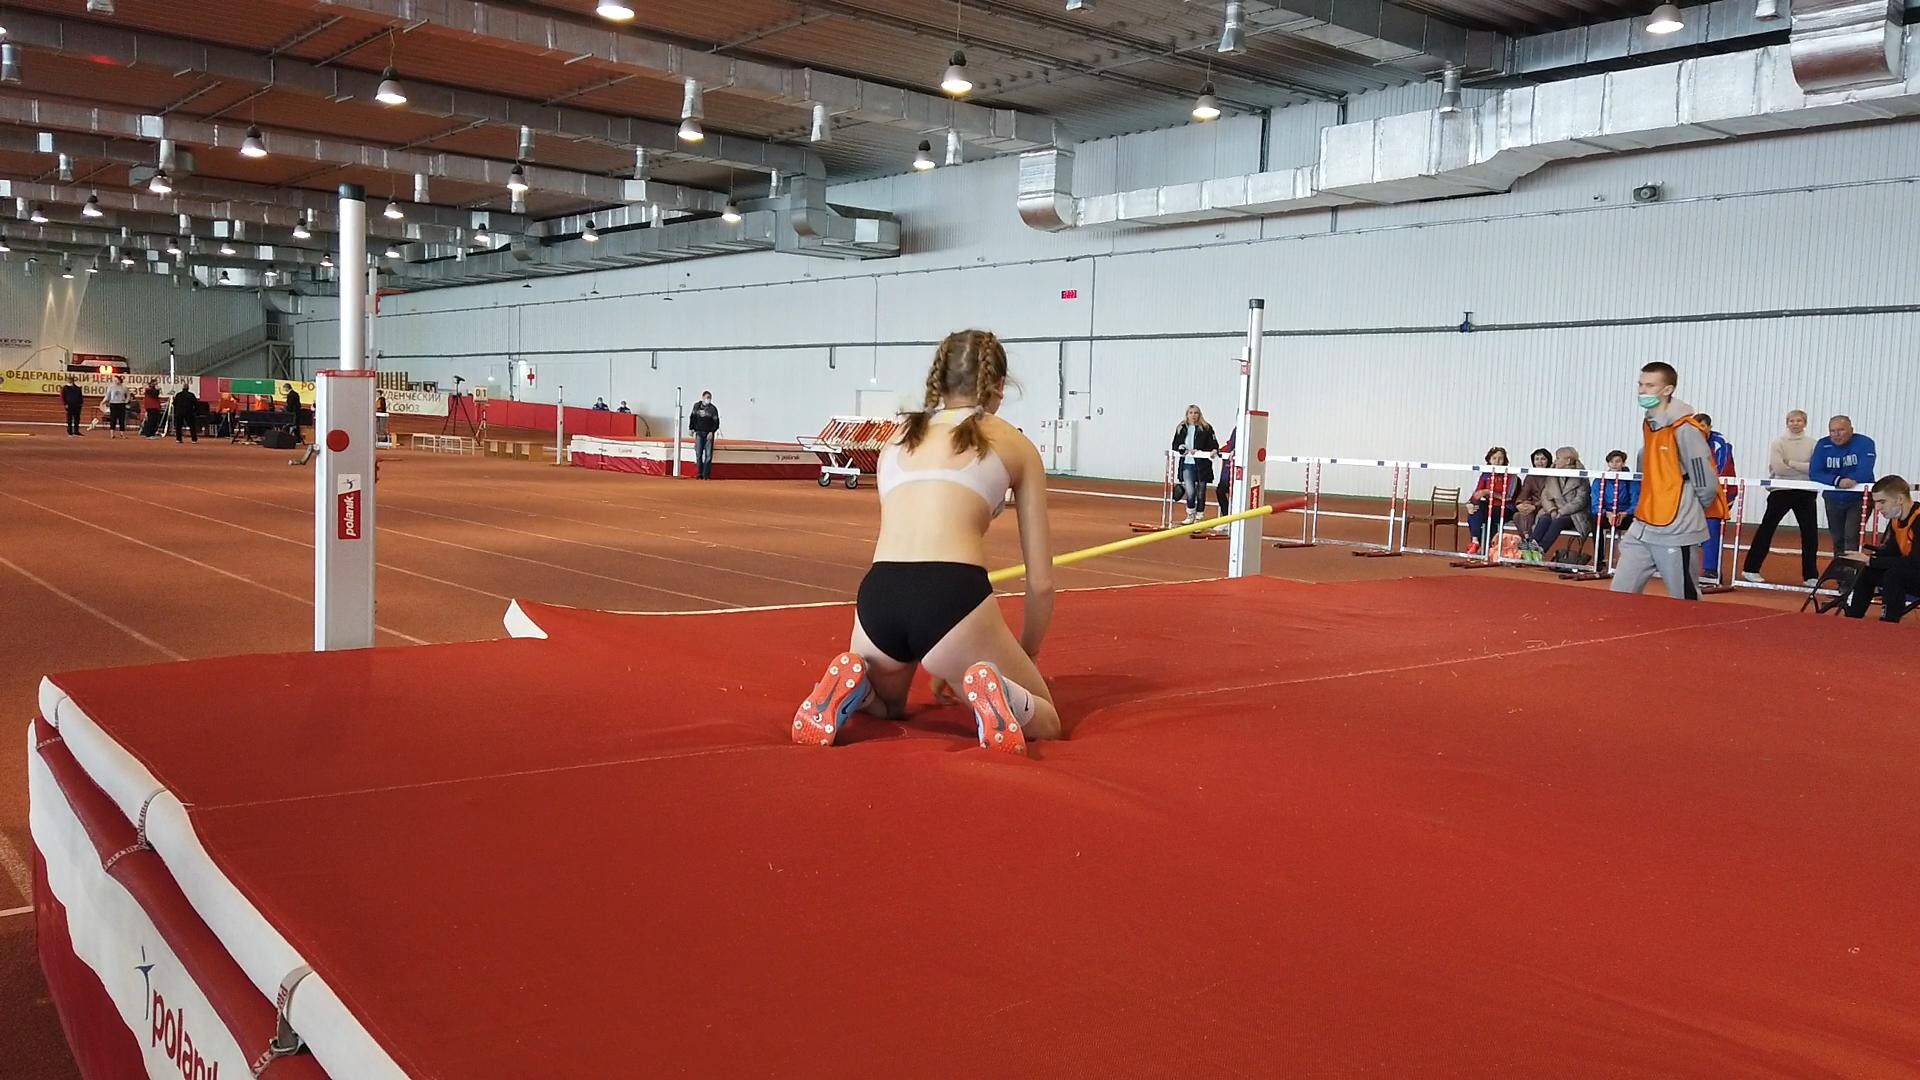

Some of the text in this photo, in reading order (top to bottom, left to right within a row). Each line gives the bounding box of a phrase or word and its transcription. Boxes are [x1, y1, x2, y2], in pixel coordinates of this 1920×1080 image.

[6, 369, 90, 383] ФЕДЕРАЛЬНЫЙ
[92, 373, 126, 385] ЦЕНР
[383, 390, 442, 403] УДЕНЧЕСКИЙ
[392, 403, 420, 412] СОЮЗ
[343, 495, 357, 537] polanik
[152, 988, 219, 1080] polan
